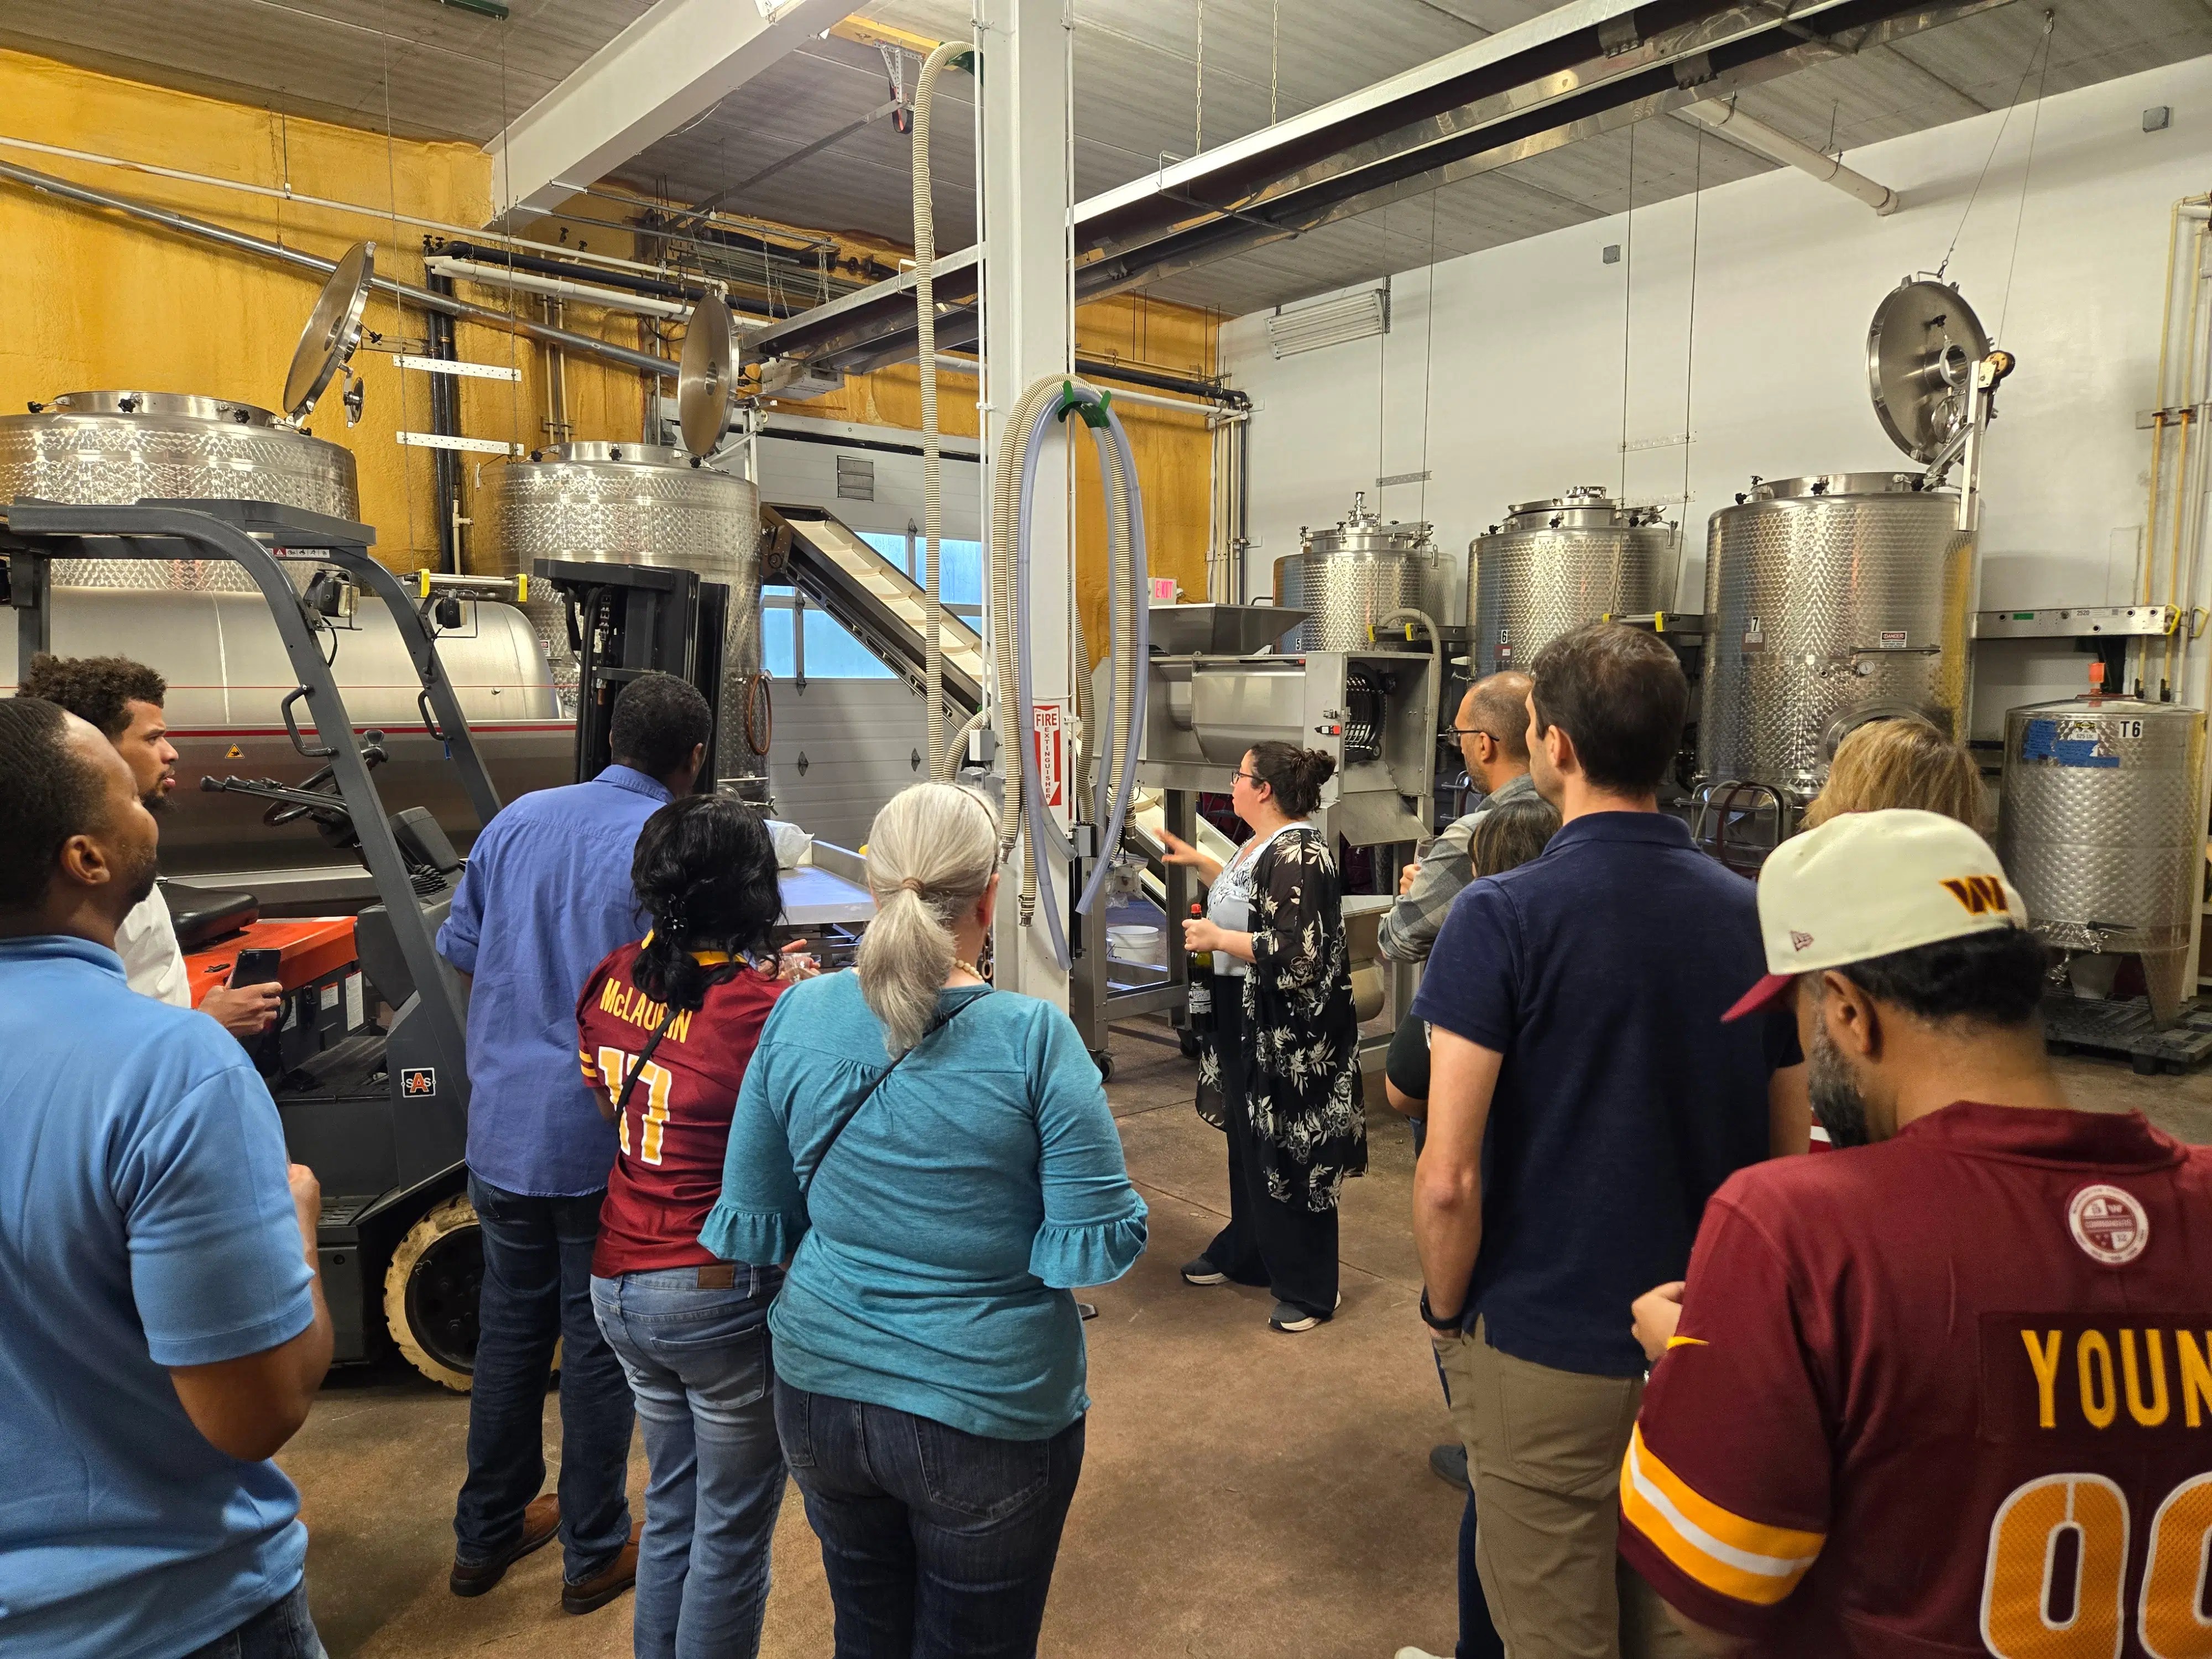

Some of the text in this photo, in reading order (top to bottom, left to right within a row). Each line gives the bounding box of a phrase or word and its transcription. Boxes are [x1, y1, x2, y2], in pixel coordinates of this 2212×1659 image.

[1156, 580, 1173, 598] EXIT
[1753, 617, 1759, 631] 7
[1502, 630, 1507, 643] 6
[1296, 639, 1300, 650] 5
[1036, 713, 1057, 726] FIRE
[406, 1073, 431, 1093] SAS
[598, 1046, 672, 1166] 17
